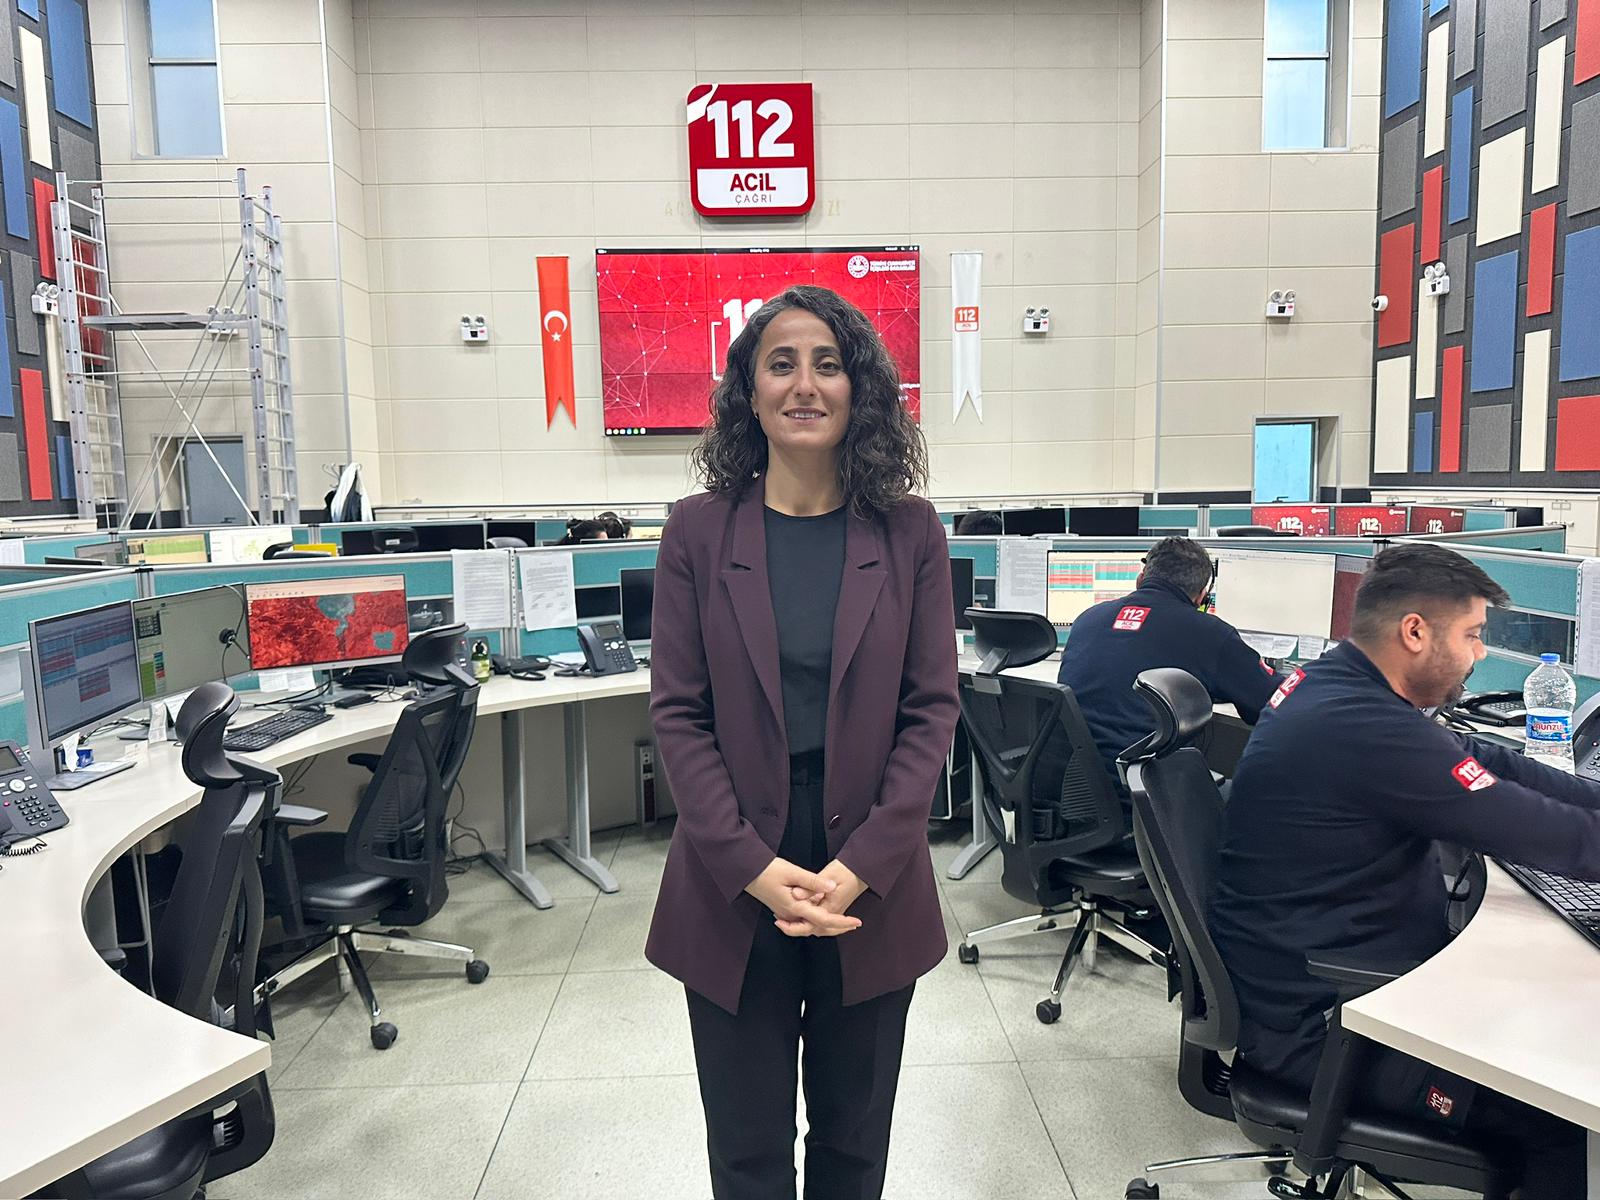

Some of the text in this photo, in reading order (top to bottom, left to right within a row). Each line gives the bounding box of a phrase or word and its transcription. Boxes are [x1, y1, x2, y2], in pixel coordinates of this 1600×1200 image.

[707, 99, 795, 159] 112
[730, 172, 777, 191] ACİL
[735, 193, 773, 205] ÇAĞRI
[958, 309, 976, 321] 112
[1280, 517, 1300, 530] 112
[1360, 517, 1379, 531] 112
[1428, 519, 1443, 533] 112
[1123, 609, 1145, 620] 112
[1457, 761, 1484, 782] 112
[1430, 1092, 1444, 1108] 112
